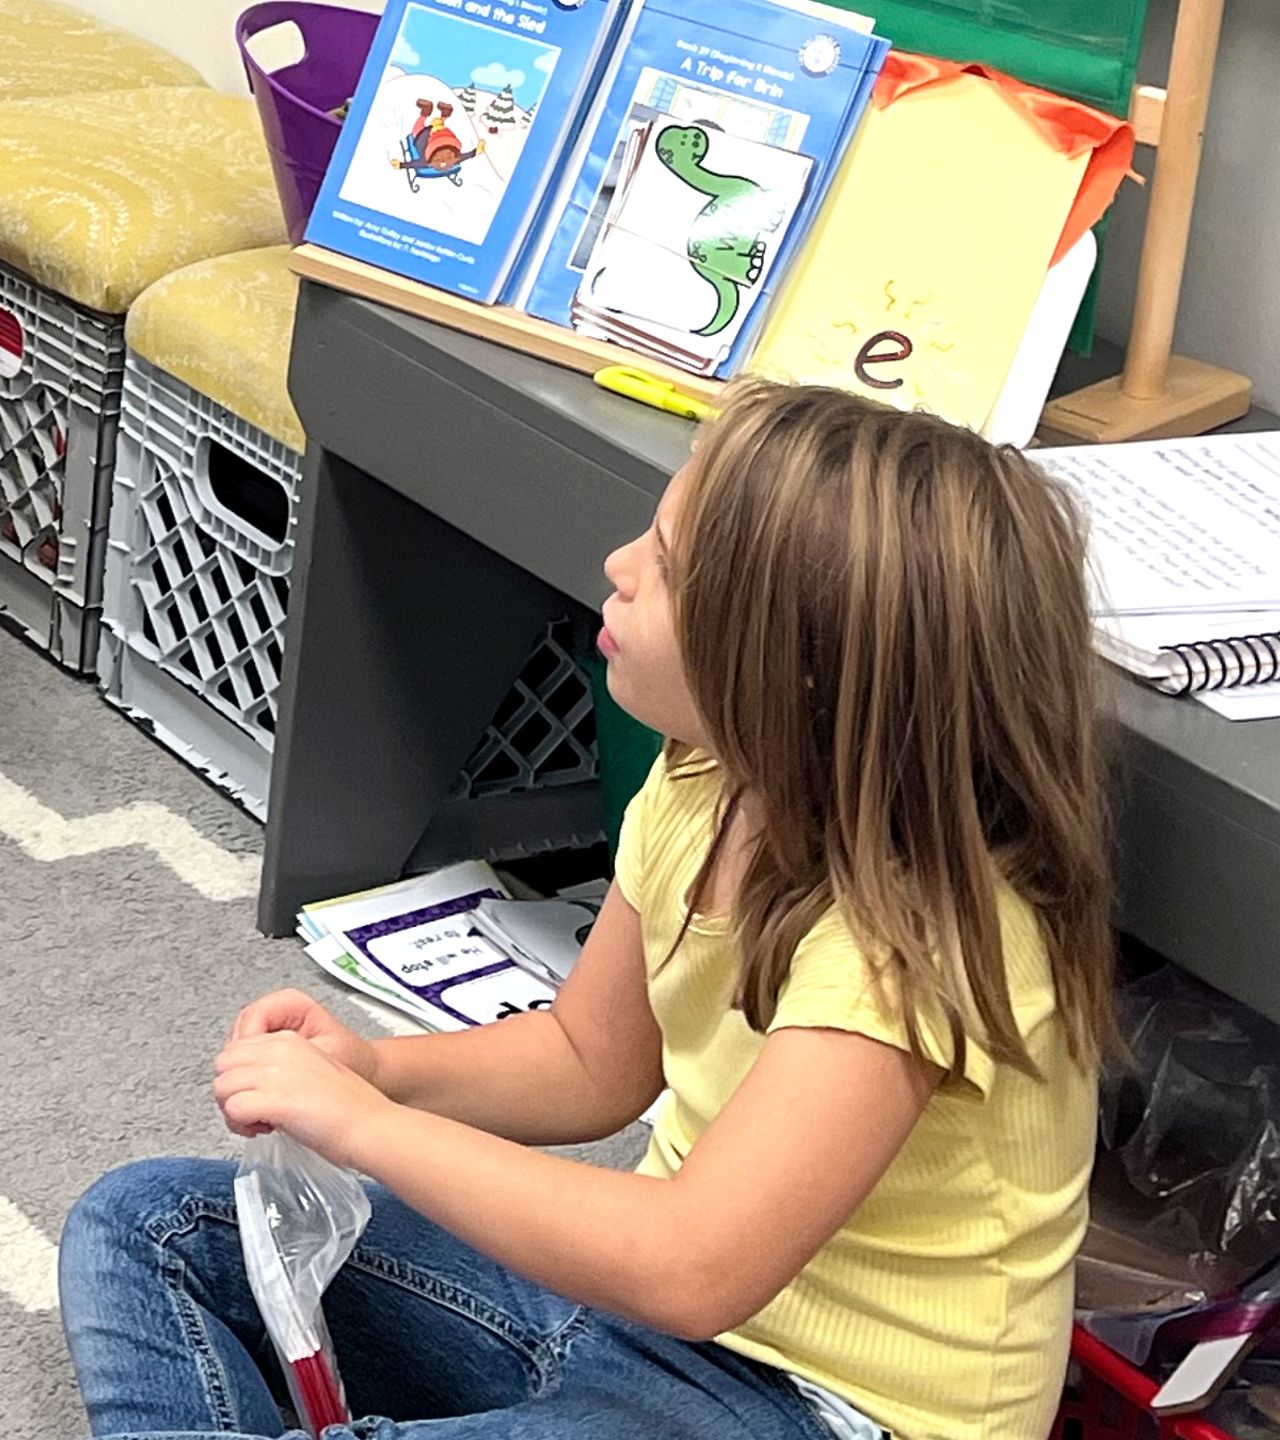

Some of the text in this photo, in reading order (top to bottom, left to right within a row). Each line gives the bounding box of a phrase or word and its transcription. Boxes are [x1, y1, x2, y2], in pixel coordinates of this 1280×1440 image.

[464, 1, 492, 18] and
[492, 7, 515, 25] the
[517, 14, 547, 35] Sled
[680, 56, 692, 72] A
[696, 60, 725, 82] Trip
[753, 77, 785, 99] Brin
[854, 330, 914, 390] e
